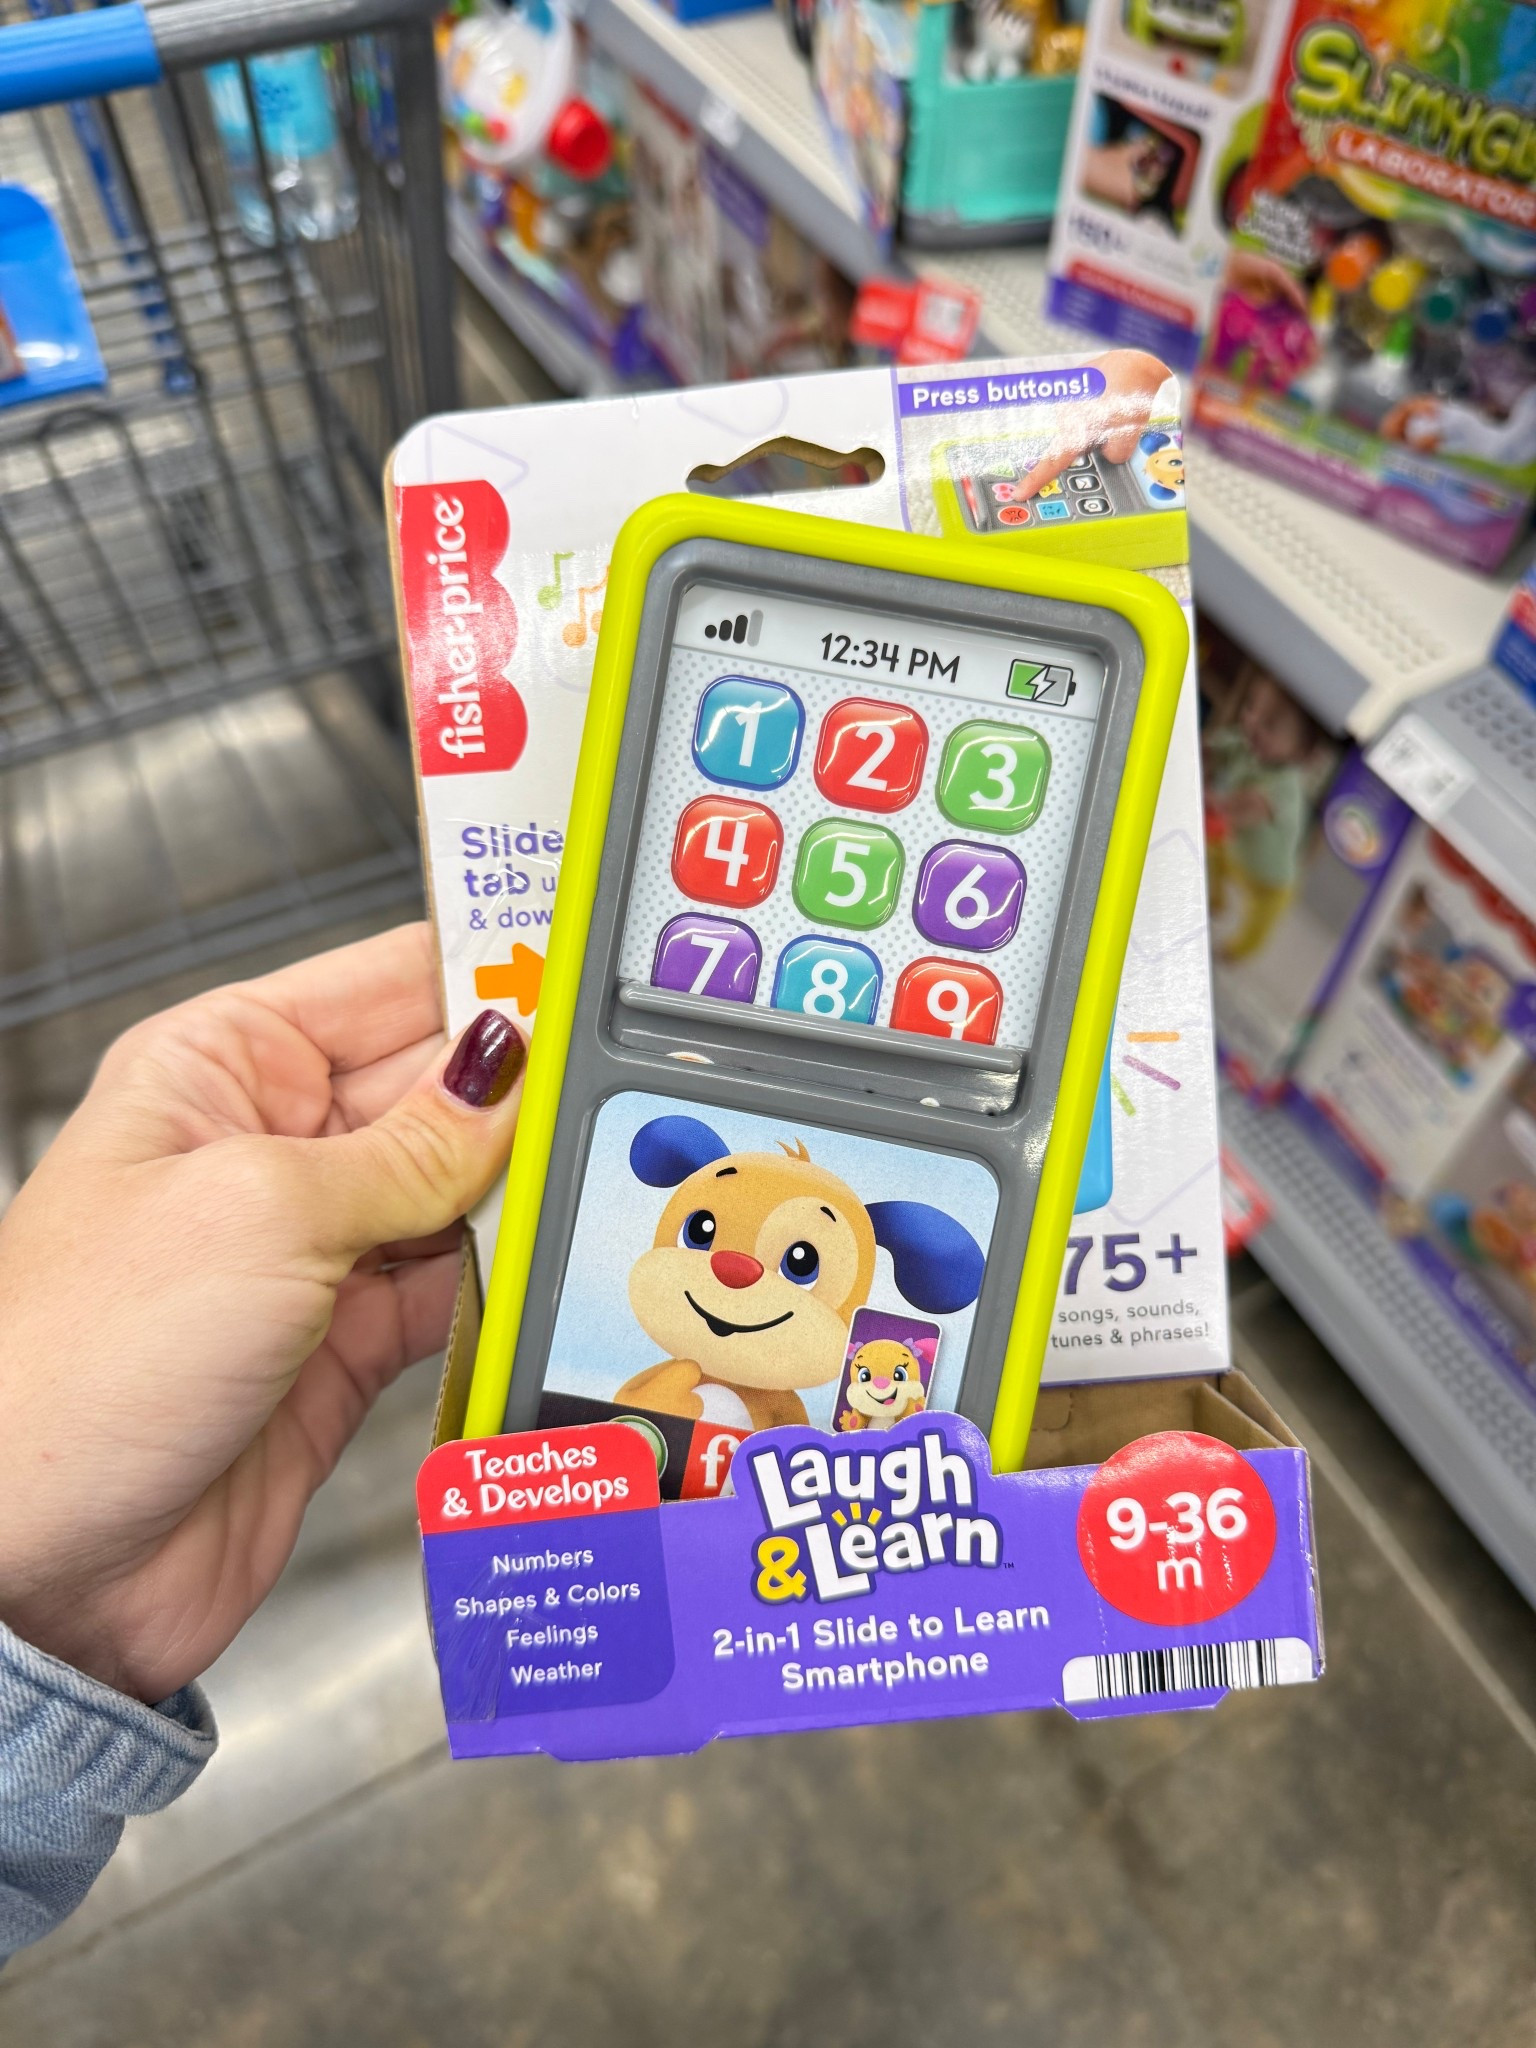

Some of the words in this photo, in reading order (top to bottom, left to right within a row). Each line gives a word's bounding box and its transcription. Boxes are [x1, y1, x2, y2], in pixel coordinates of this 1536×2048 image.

[912, 385, 981, 409] Press
[987, 372, 1090, 402] buttons!
[427, 496, 487, 759] fisher-price
[820, 632, 900, 673] 12:34
[907, 650, 962, 684] PM
[734, 701, 763, 768] 1
[845, 724, 896, 793] 2
[968, 742, 1018, 810] 3
[461, 822, 565, 860] Slide
[463, 863, 531, 898] tab
[541, 876, 556, 893] u
[703, 819, 750, 887] 4
[823, 840, 871, 908] 5
[943, 863, 990, 931] 6
[469, 908, 489, 930] &
[498, 905, 554, 929] dow
[688, 934, 731, 995] 7
[801, 958, 850, 1020] 8
[926, 979, 971, 1042] 9
[1063, 1231, 1198, 1296] 75+
[1057, 1308, 1119, 1325] songs,
[1126, 1299, 1200, 1319] sounds,
[1050, 1333, 1103, 1349] tunes
[1109, 1328, 1124, 1344] &
[1130, 1321, 1210, 1346] phrases!
[465, 1441, 598, 1481] Teaches
[441, 1486, 473, 1517] &
[480, 1473, 630, 1514] Develops
[752, 1433, 972, 1530] Laugh
[1105, 1487, 1248, 1551] 9-36
[492, 1549, 595, 1575] Numbers
[756, 1536, 807, 1601] &
[804, 1511, 999, 1602] Learn
[1157, 1556, 1203, 1592] m
[455, 1592, 538, 1617] Shapes
[544, 1587, 561, 1606] &
[567, 1582, 641, 1602] Colors
[506, 1623, 599, 1648] Feelings
[712, 1622, 801, 1657] 2-in-1
[812, 1615, 899, 1646] Slide
[908, 1613, 944, 1638] to
[954, 1604, 1050, 1635] Learn
[510, 1660, 603, 1684] Weather
[781, 1651, 990, 1689] Smartphone
